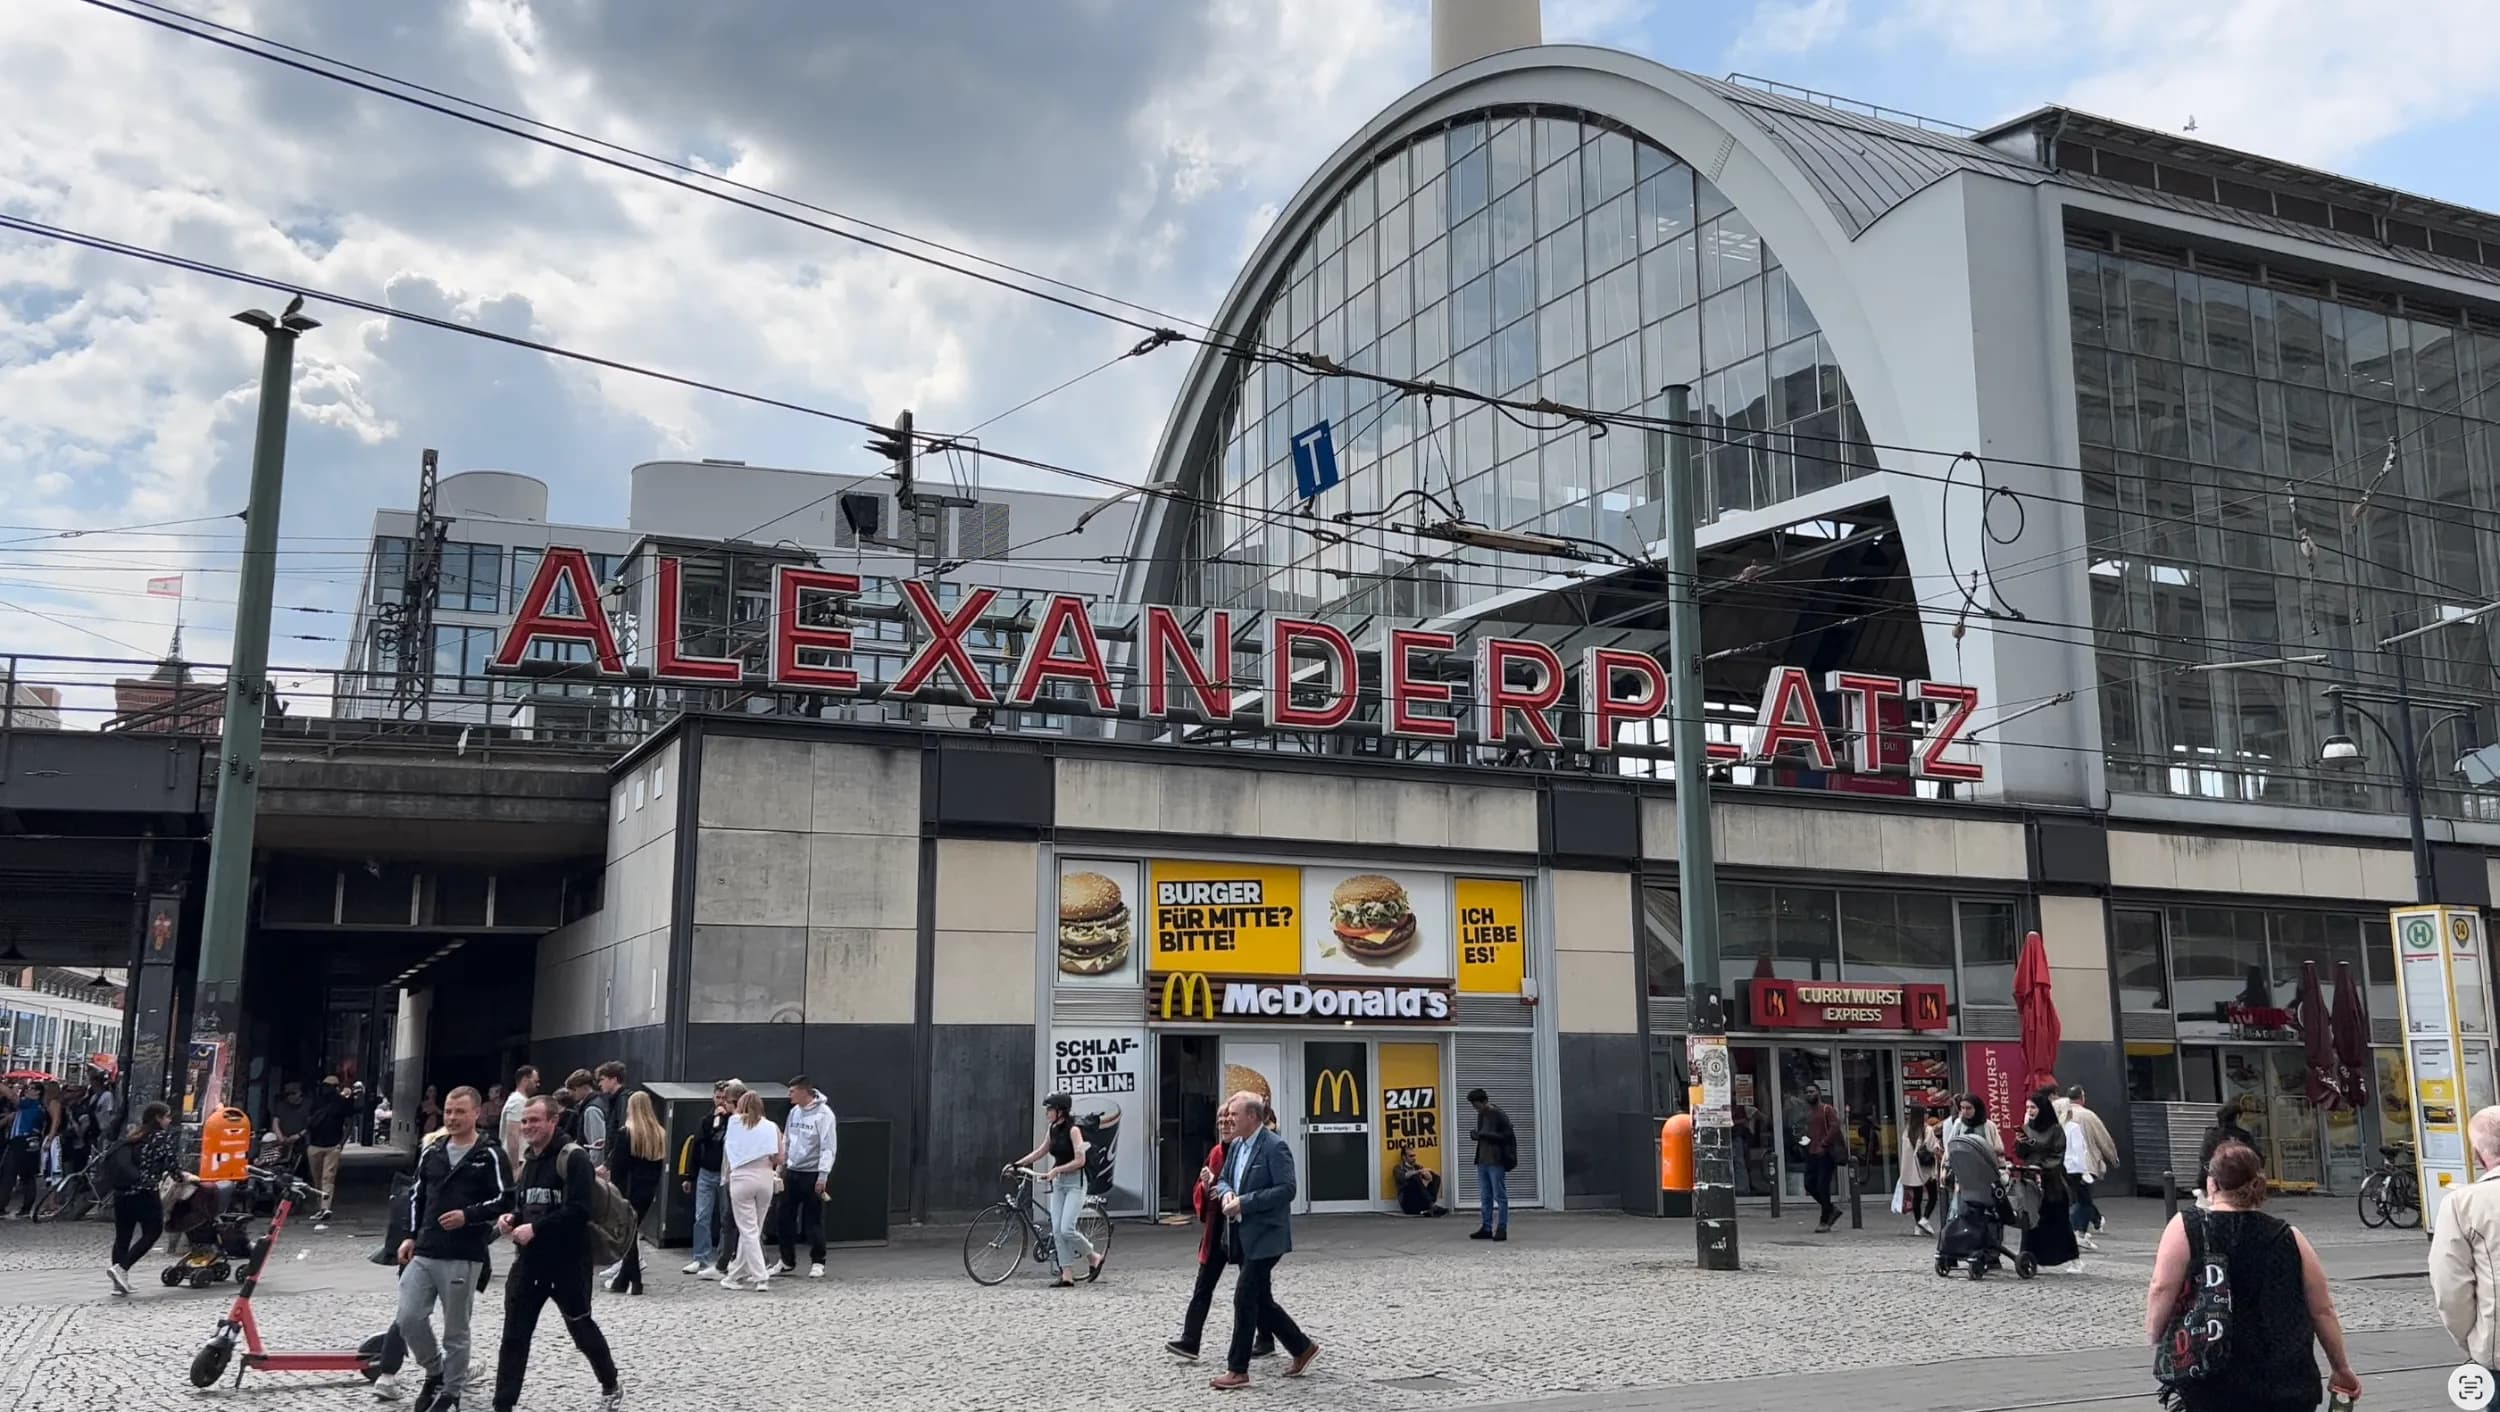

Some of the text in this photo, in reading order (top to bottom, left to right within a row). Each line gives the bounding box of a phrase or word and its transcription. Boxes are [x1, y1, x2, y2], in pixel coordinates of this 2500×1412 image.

[1299, 429, 1322, 486] T
[1158, 881, 1262, 905] BURGER
[1208, 906, 1294, 929] MITTE?
[1461, 907, 1495, 926] ICH
[1159, 929, 1236, 952] BITTE!
[1463, 925, 1518, 944] LIEBE
[1465, 946, 1496, 965] ES!
[1222, 983, 1449, 1018] McDonald's
[1798, 987, 1904, 1006] CURRYWURST
[1823, 1007, 1883, 1022] EXPRESS
[1055, 1038, 1139, 1058] SCHLAF-
[1056, 1055, 1117, 1075] LOS IN
[1057, 1073, 1134, 1094] BERLIN:
[1385, 1088, 1434, 1110] 24/7
[1998, 1071, 2011, 1129] EXPRESS
[1387, 1137, 1438, 1151] DICH DA!
[2205, 1264, 2225, 1288] D
